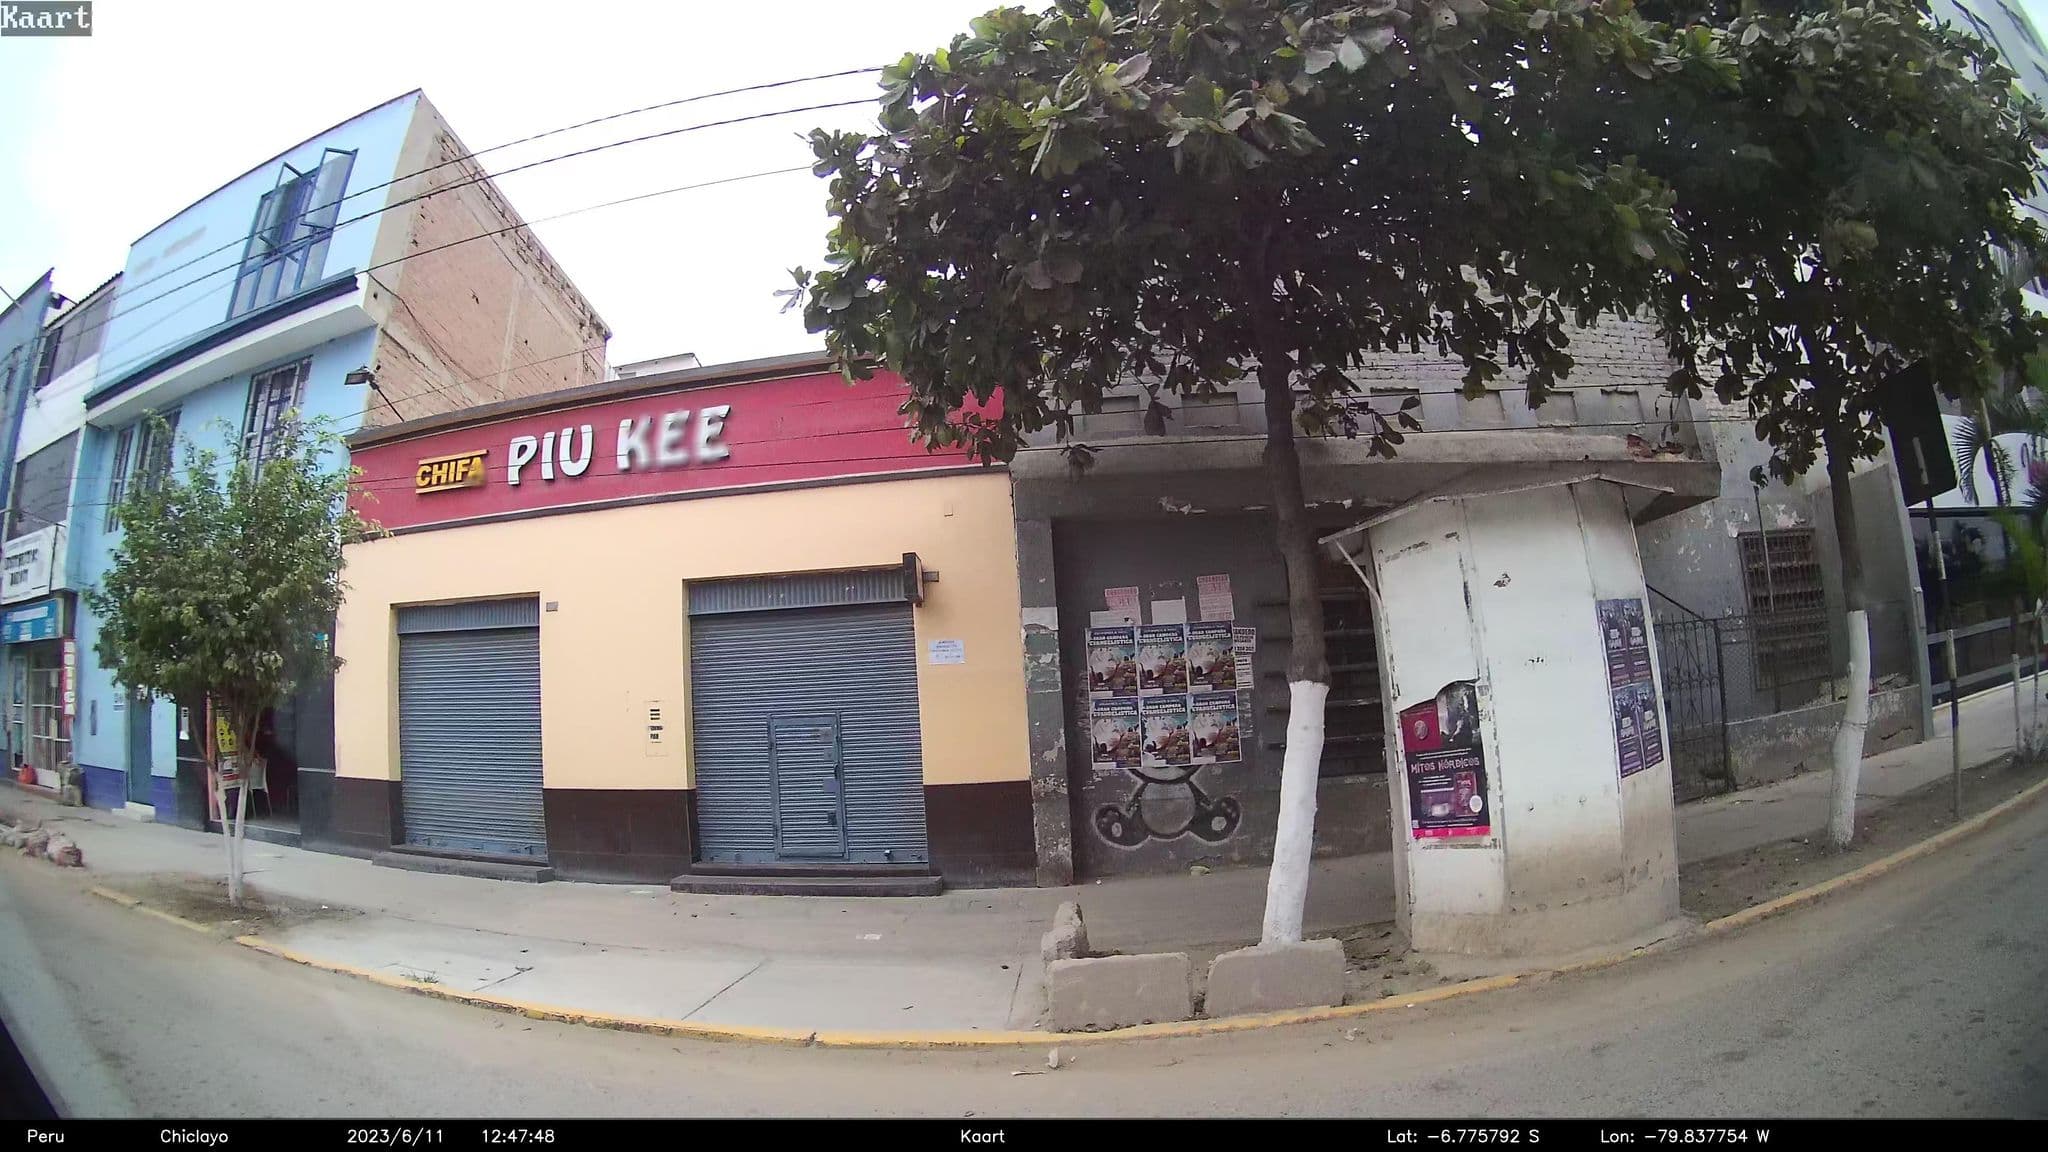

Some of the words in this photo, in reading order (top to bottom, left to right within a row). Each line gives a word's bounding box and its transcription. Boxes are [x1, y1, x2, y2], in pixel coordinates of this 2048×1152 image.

[415, 455, 485, 487] CHIFA
[507, 424, 593, 485] PIU
[616, 404, 731, 471] KEE
